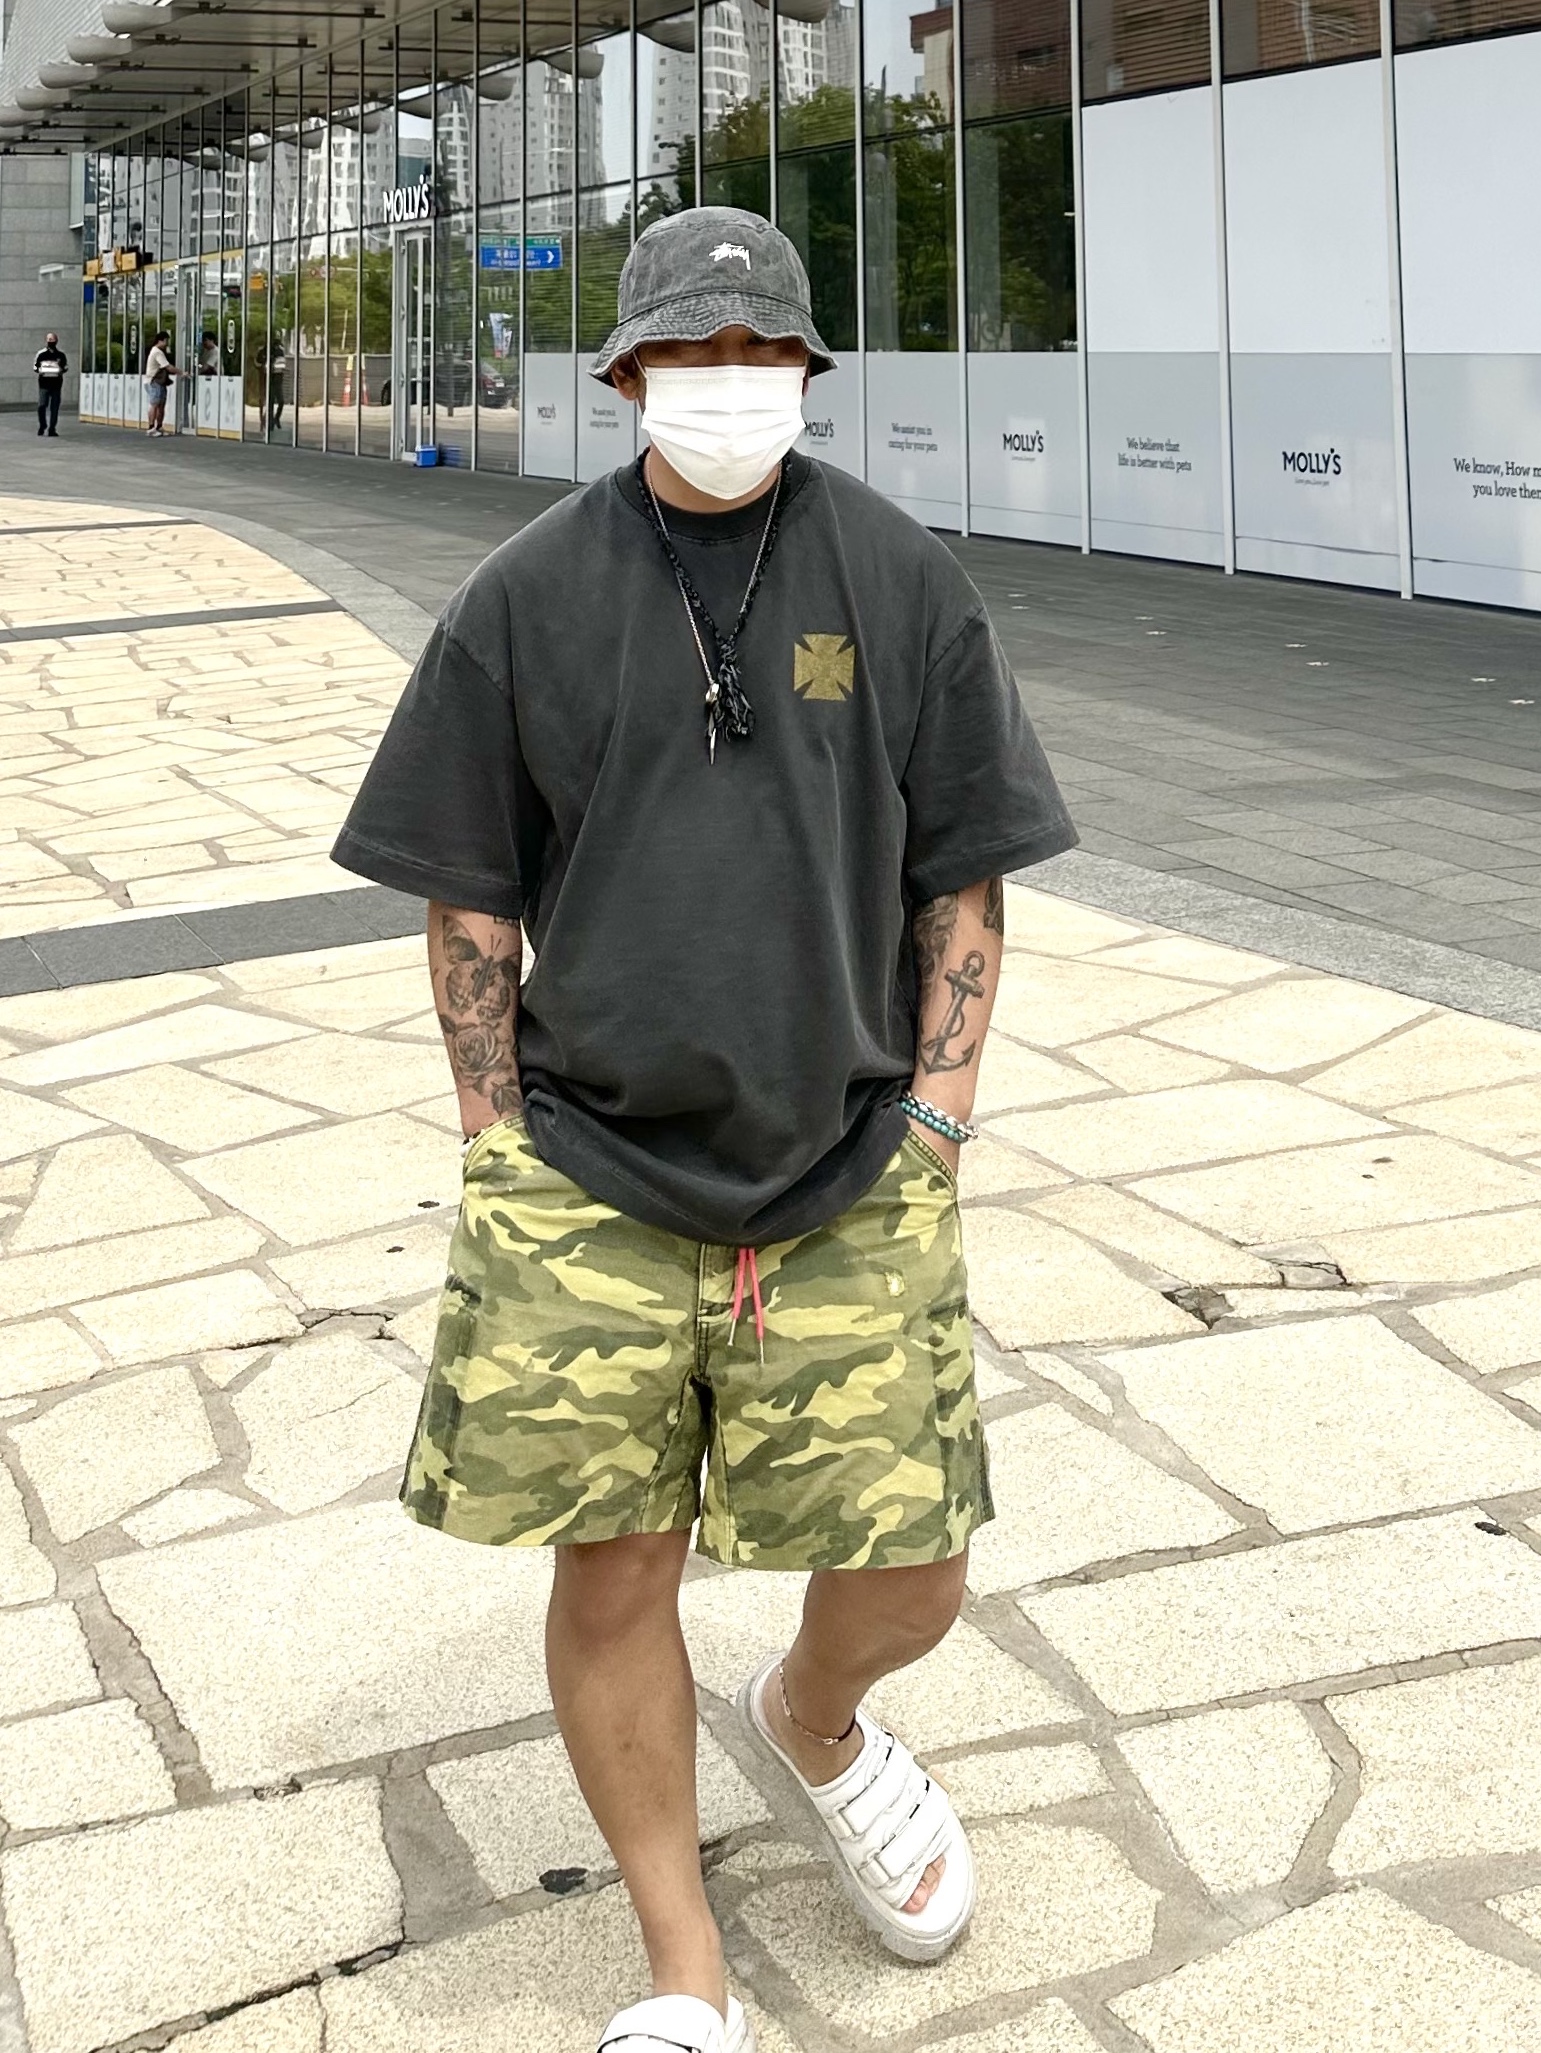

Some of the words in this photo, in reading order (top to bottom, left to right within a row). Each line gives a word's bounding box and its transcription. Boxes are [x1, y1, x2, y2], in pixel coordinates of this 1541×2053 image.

[383, 174, 430, 223] MOLLY'S
[1002, 429, 1044, 453] MOLLY'S
[1126, 437, 1139, 449] We
[1281, 447, 1342, 475] MOLLY'S
[1453, 457, 1471, 473] We
[1472, 457, 1504, 477] know,
[1505, 460, 1530, 477] How
[1473, 484, 1492, 498] you
[1494, 480, 1517, 497] love
